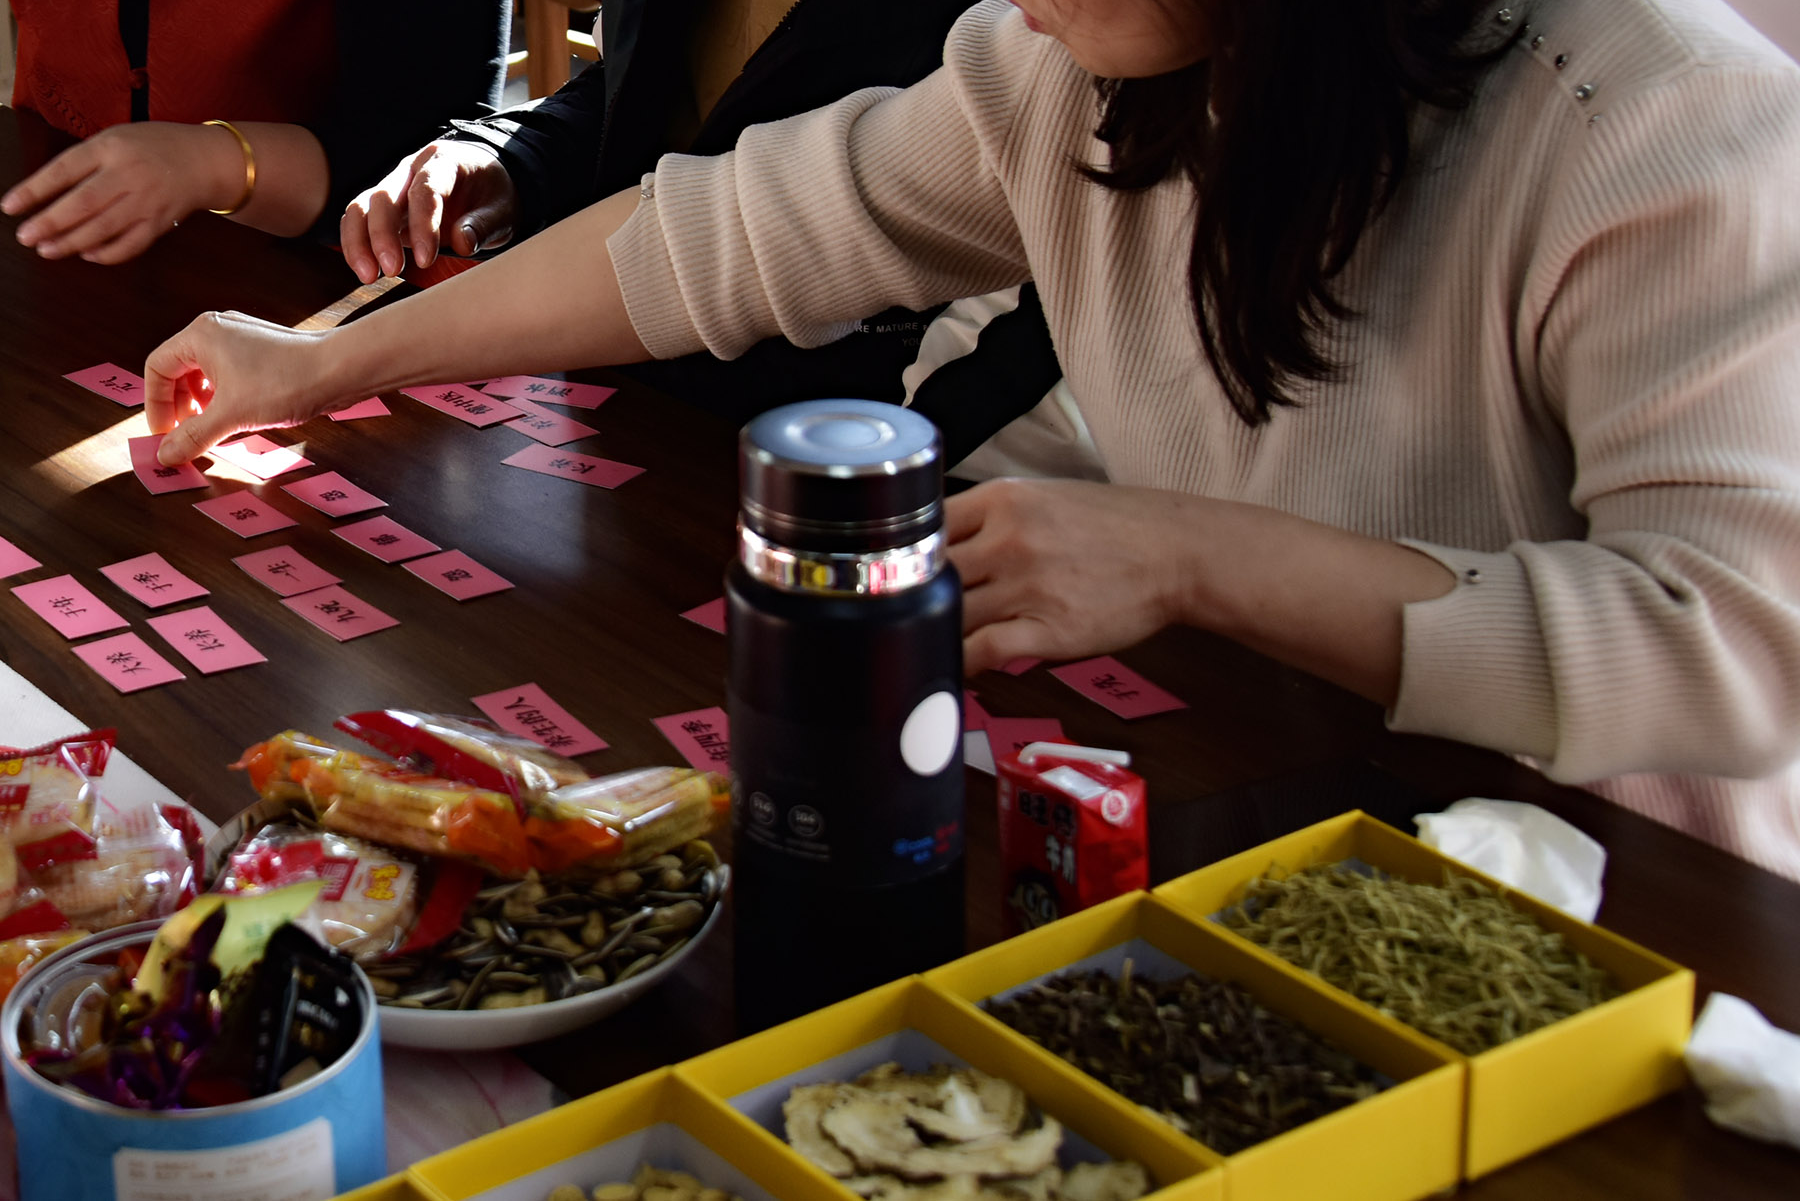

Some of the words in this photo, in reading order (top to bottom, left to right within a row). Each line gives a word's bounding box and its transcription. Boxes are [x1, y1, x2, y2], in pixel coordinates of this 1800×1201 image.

[876, 322, 918, 334] MATURE
[435, 391, 494, 415] 懂中医
[268, 560, 300, 581] 一生
[133, 572, 172, 592] 于季
[314, 600, 364, 622] 九死
[184, 629, 224, 651] 长养
[106, 652, 146, 673] 大养
[1090, 673, 1140, 700] 于先
[504, 695, 578, 749] 养生的人
